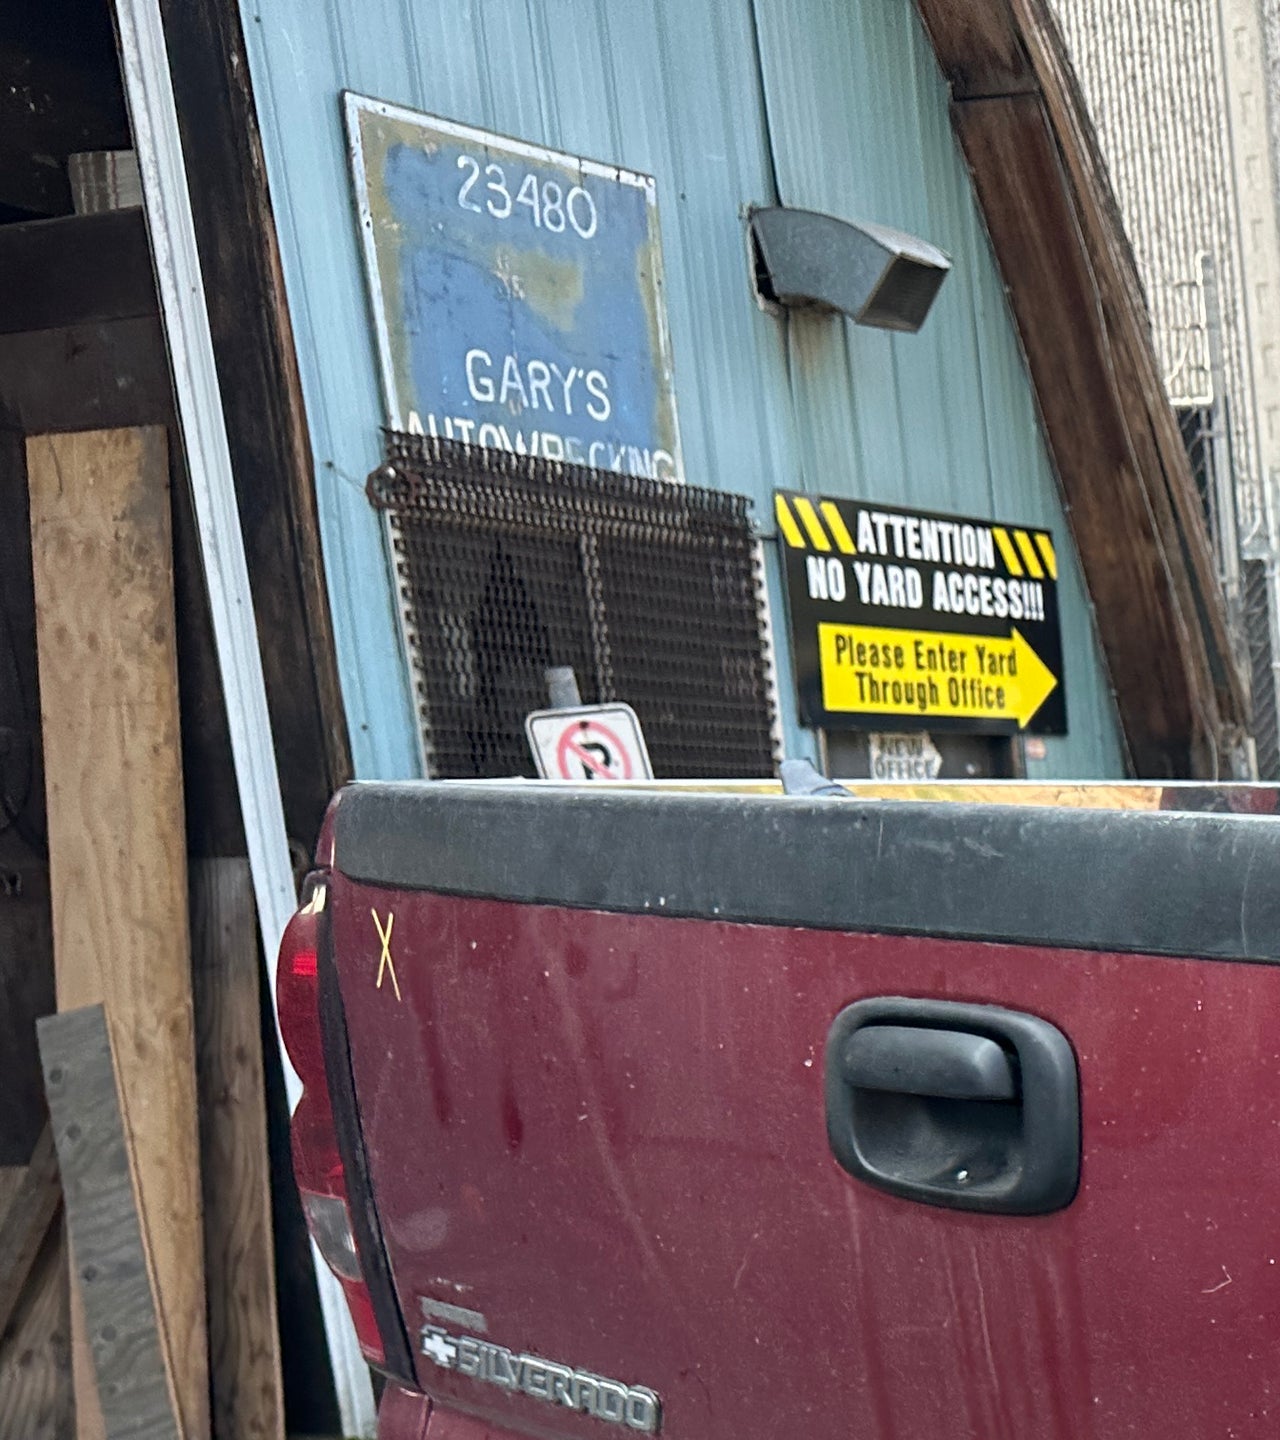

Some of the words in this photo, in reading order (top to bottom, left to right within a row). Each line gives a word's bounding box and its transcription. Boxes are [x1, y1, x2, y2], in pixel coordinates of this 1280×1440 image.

[457, 154, 598, 240] 23480
[465, 348, 612, 422] GARY'S
[856, 509, 996, 570] ATTENTION
[805, 554, 847, 602] NO
[853, 559, 924, 610] YARD
[931, 570, 1046, 622] ACCESS!!!
[834, 634, 905, 669] Please
[913, 640, 967, 673] Enter
[975, 644, 1018, 677] Yard
[855, 672, 940, 712] Through
[947, 676, 1006, 711] Office
[456, 1335, 663, 1436] SILVERADO
